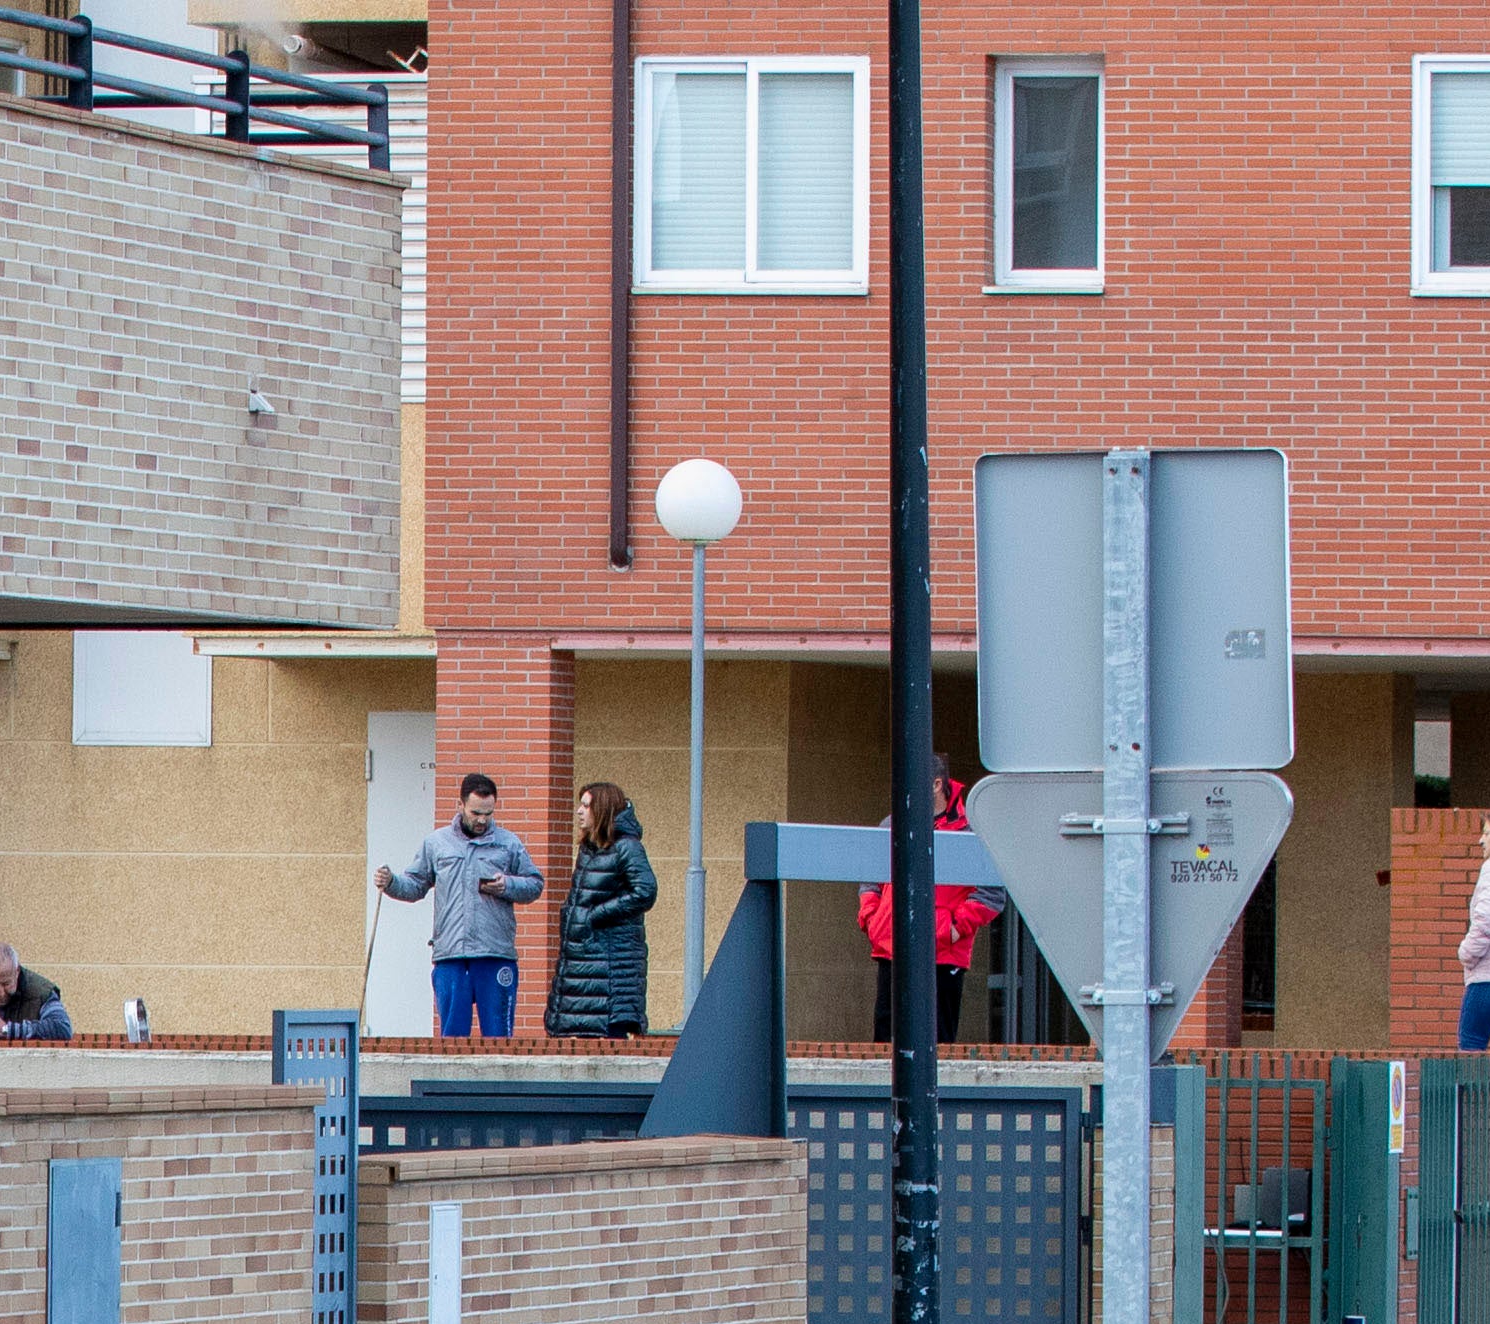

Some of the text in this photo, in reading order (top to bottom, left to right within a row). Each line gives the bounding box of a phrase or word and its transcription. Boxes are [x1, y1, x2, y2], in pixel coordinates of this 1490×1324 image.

[1171, 860, 1238, 873] TEVACAL
[1171, 873, 1238, 883] 920 21 50 72
